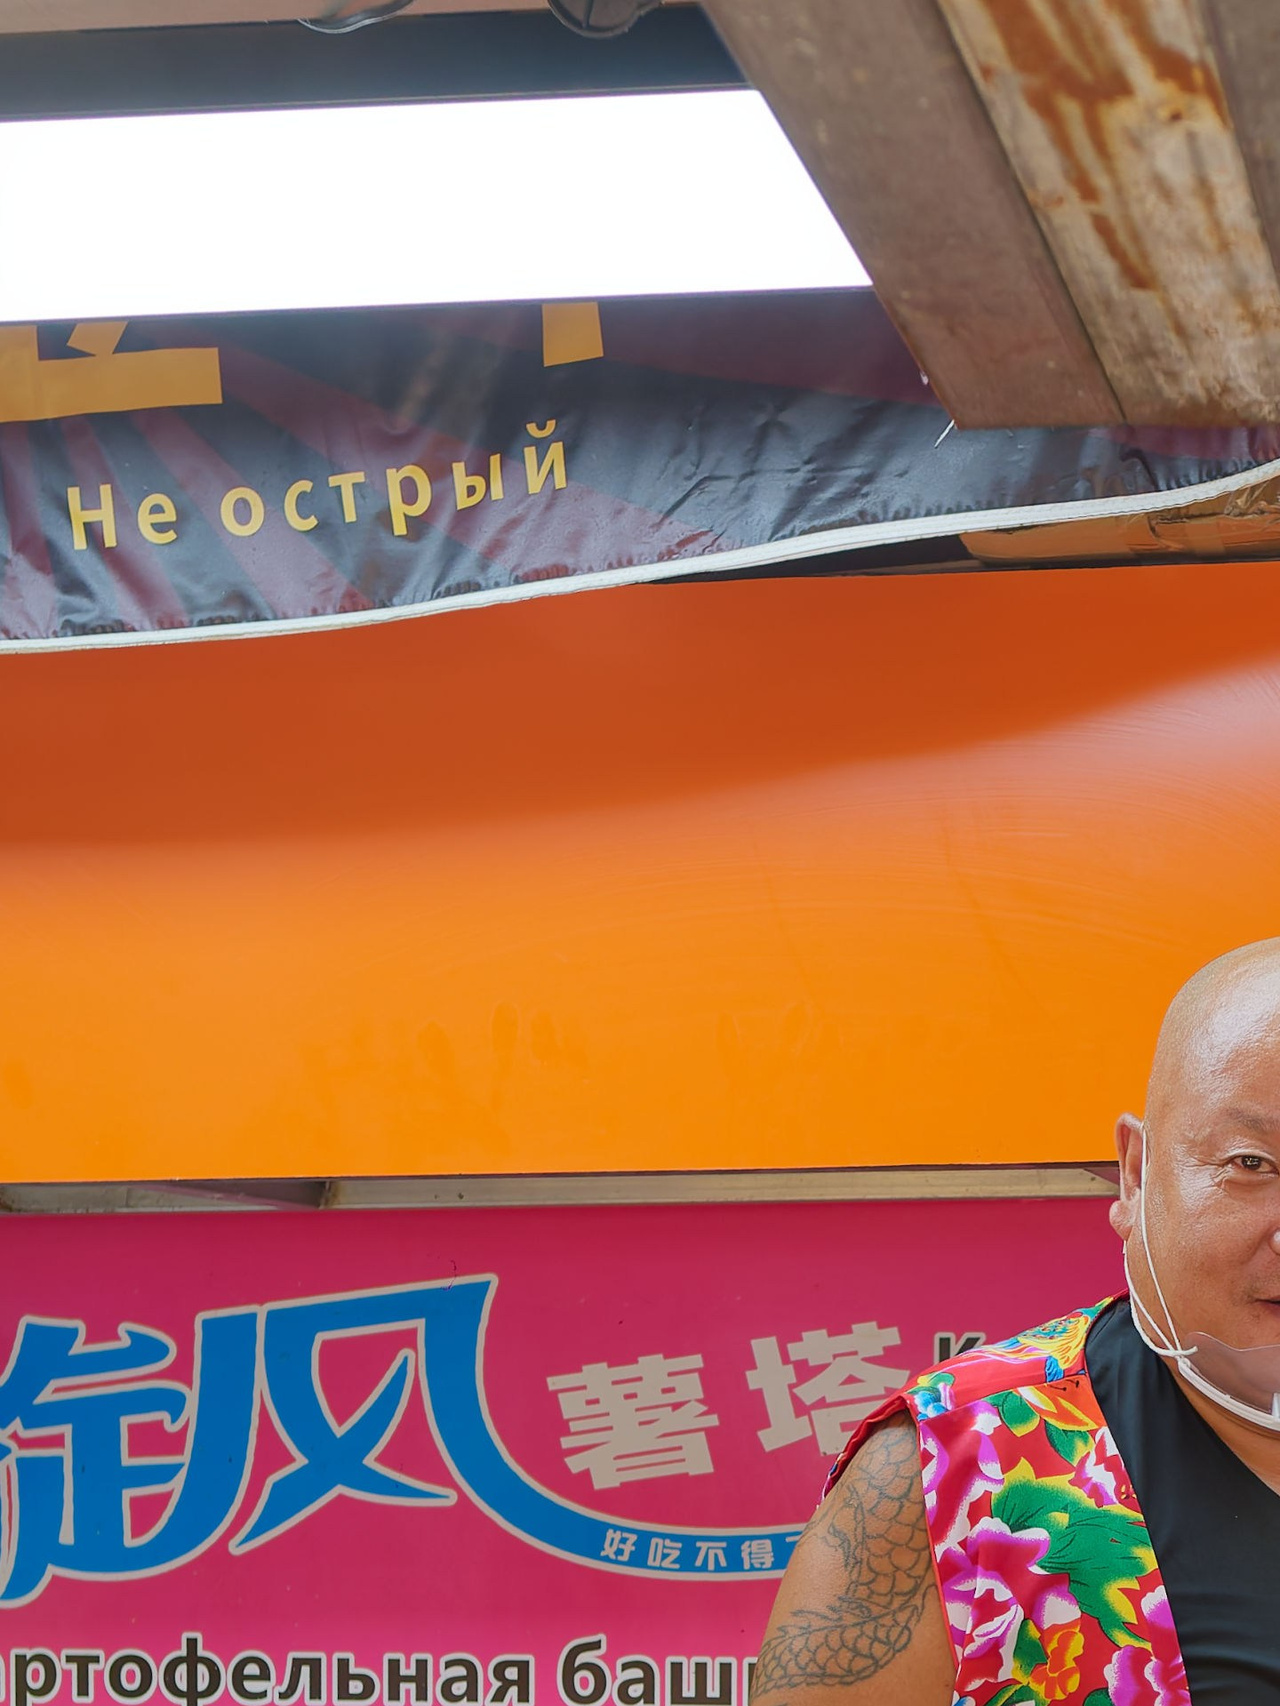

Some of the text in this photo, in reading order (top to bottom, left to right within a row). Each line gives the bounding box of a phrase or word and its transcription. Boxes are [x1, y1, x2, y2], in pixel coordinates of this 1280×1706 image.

[65, 418, 569, 552] Не острый
[547, 1320, 911, 1490] 薯塔
[600, 1528, 803, 1571] 好吃不得
